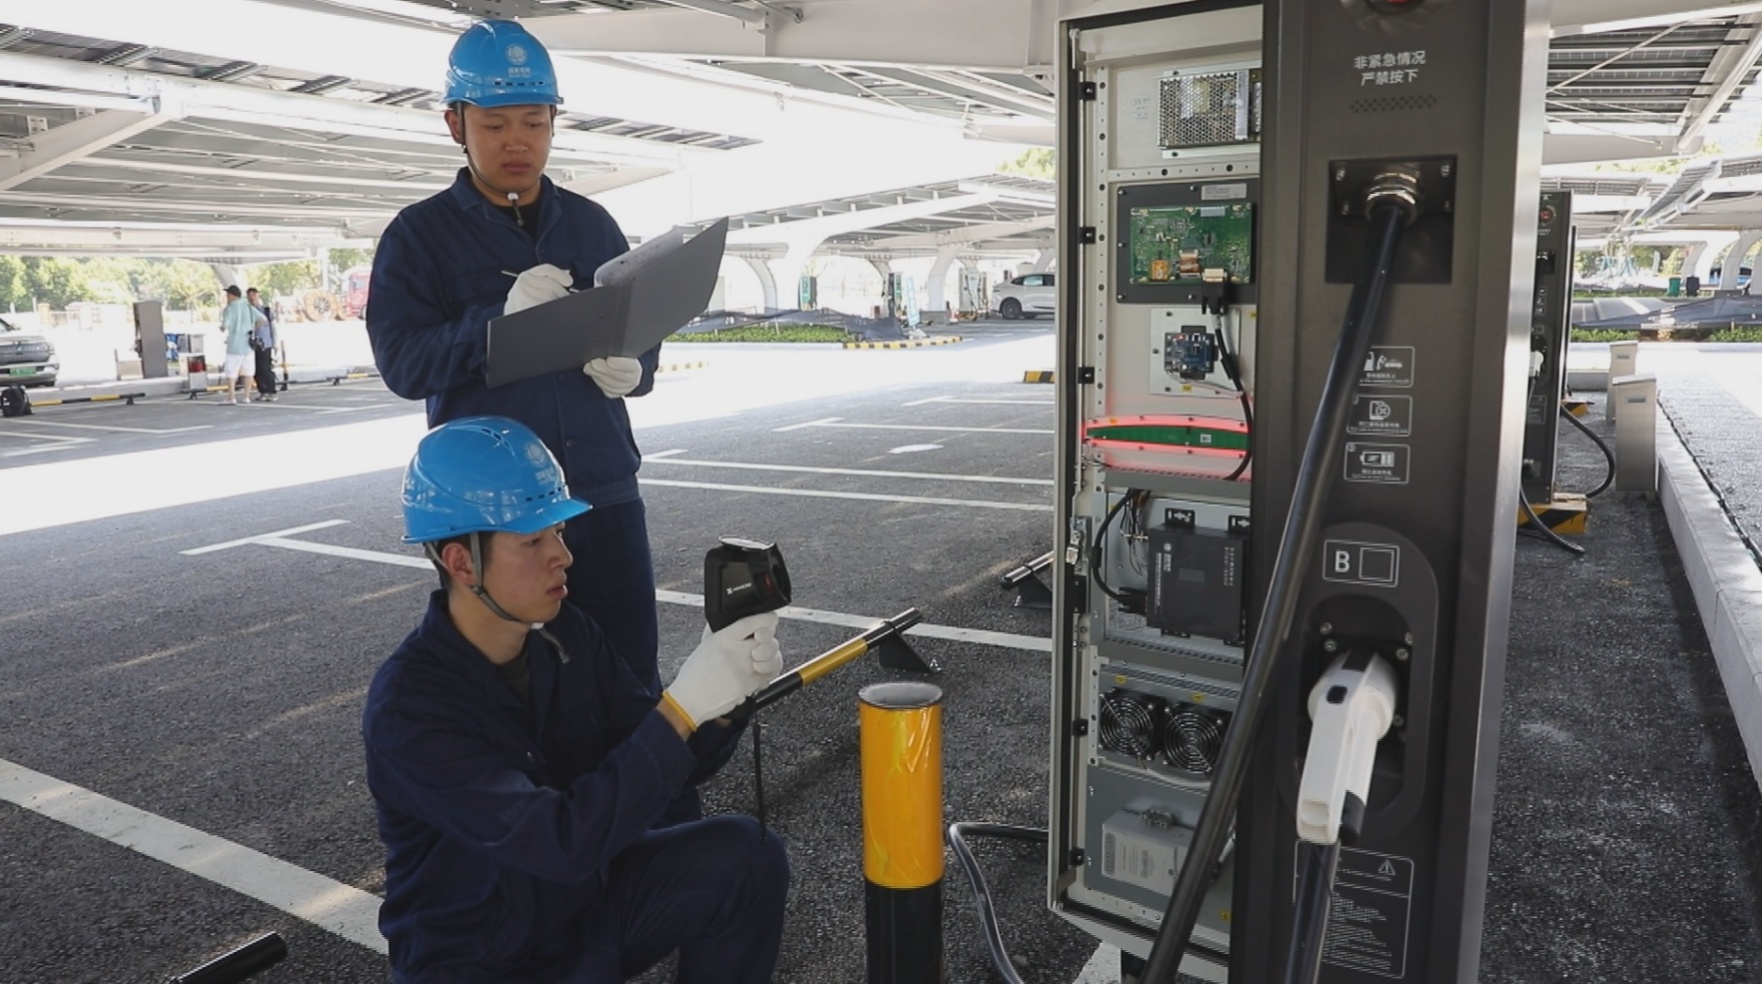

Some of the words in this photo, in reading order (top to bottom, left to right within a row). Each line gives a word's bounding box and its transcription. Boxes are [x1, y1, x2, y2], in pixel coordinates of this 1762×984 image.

[1353, 50, 1426, 70] 非紧急情况
[1361, 69, 1419, 86] 严禁按下
[1334, 550, 1350, 573] B
